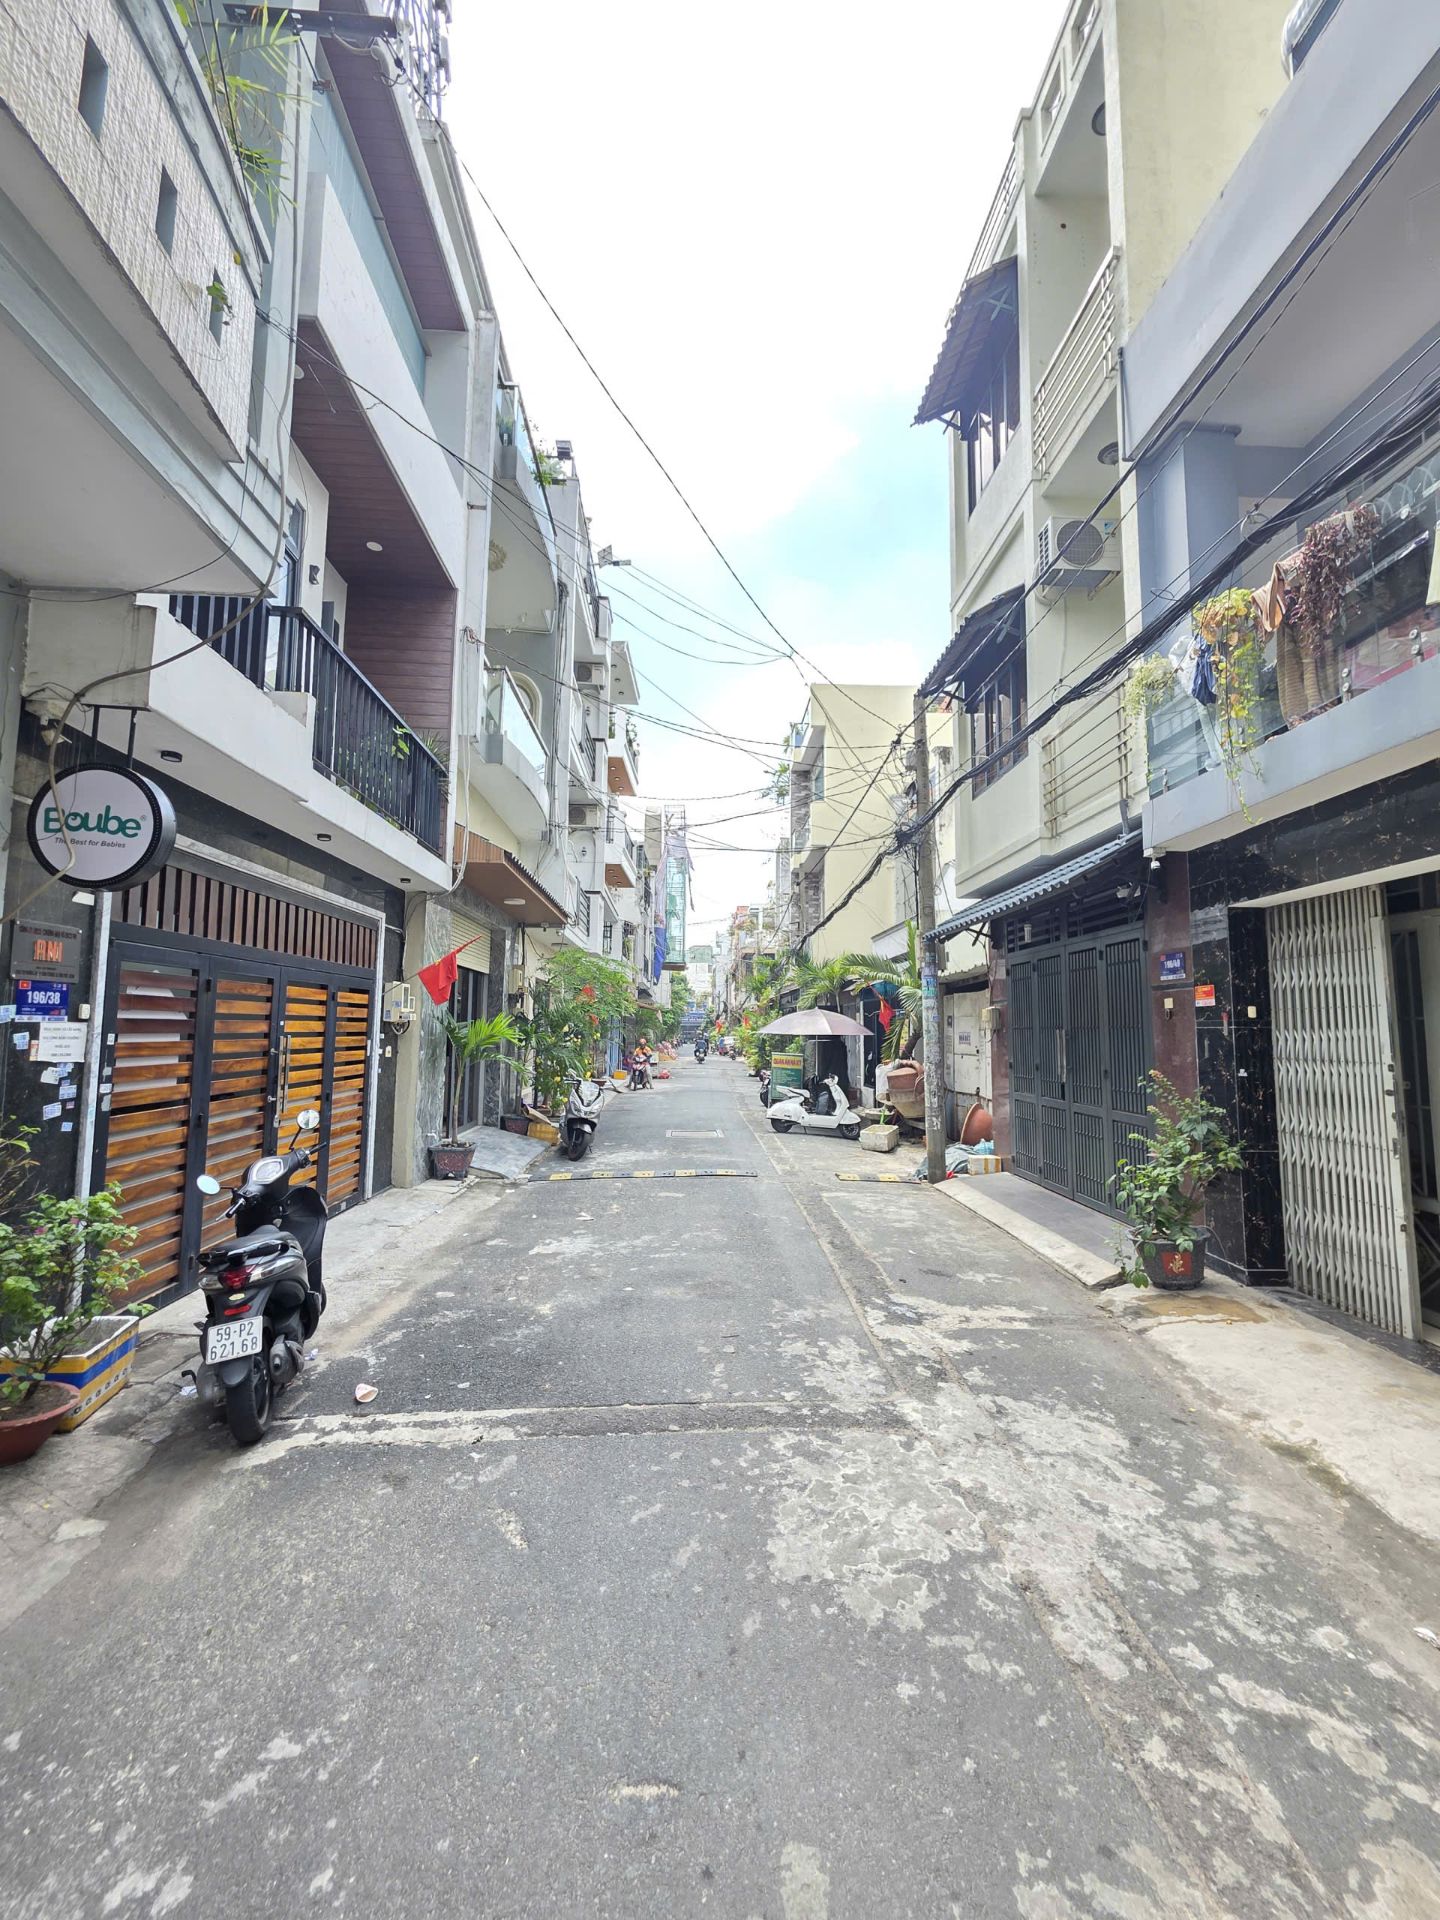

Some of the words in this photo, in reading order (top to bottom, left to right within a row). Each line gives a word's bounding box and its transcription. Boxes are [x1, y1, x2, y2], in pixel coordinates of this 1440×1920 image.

[43, 805, 141, 838] Boube
[70, 838, 87, 846] Best
[87, 839, 99, 847] for
[100, 840, 126, 849] Babies
[27, 990, 61, 1005] 196/38
[210, 1336, 258, 1361] 621.68
